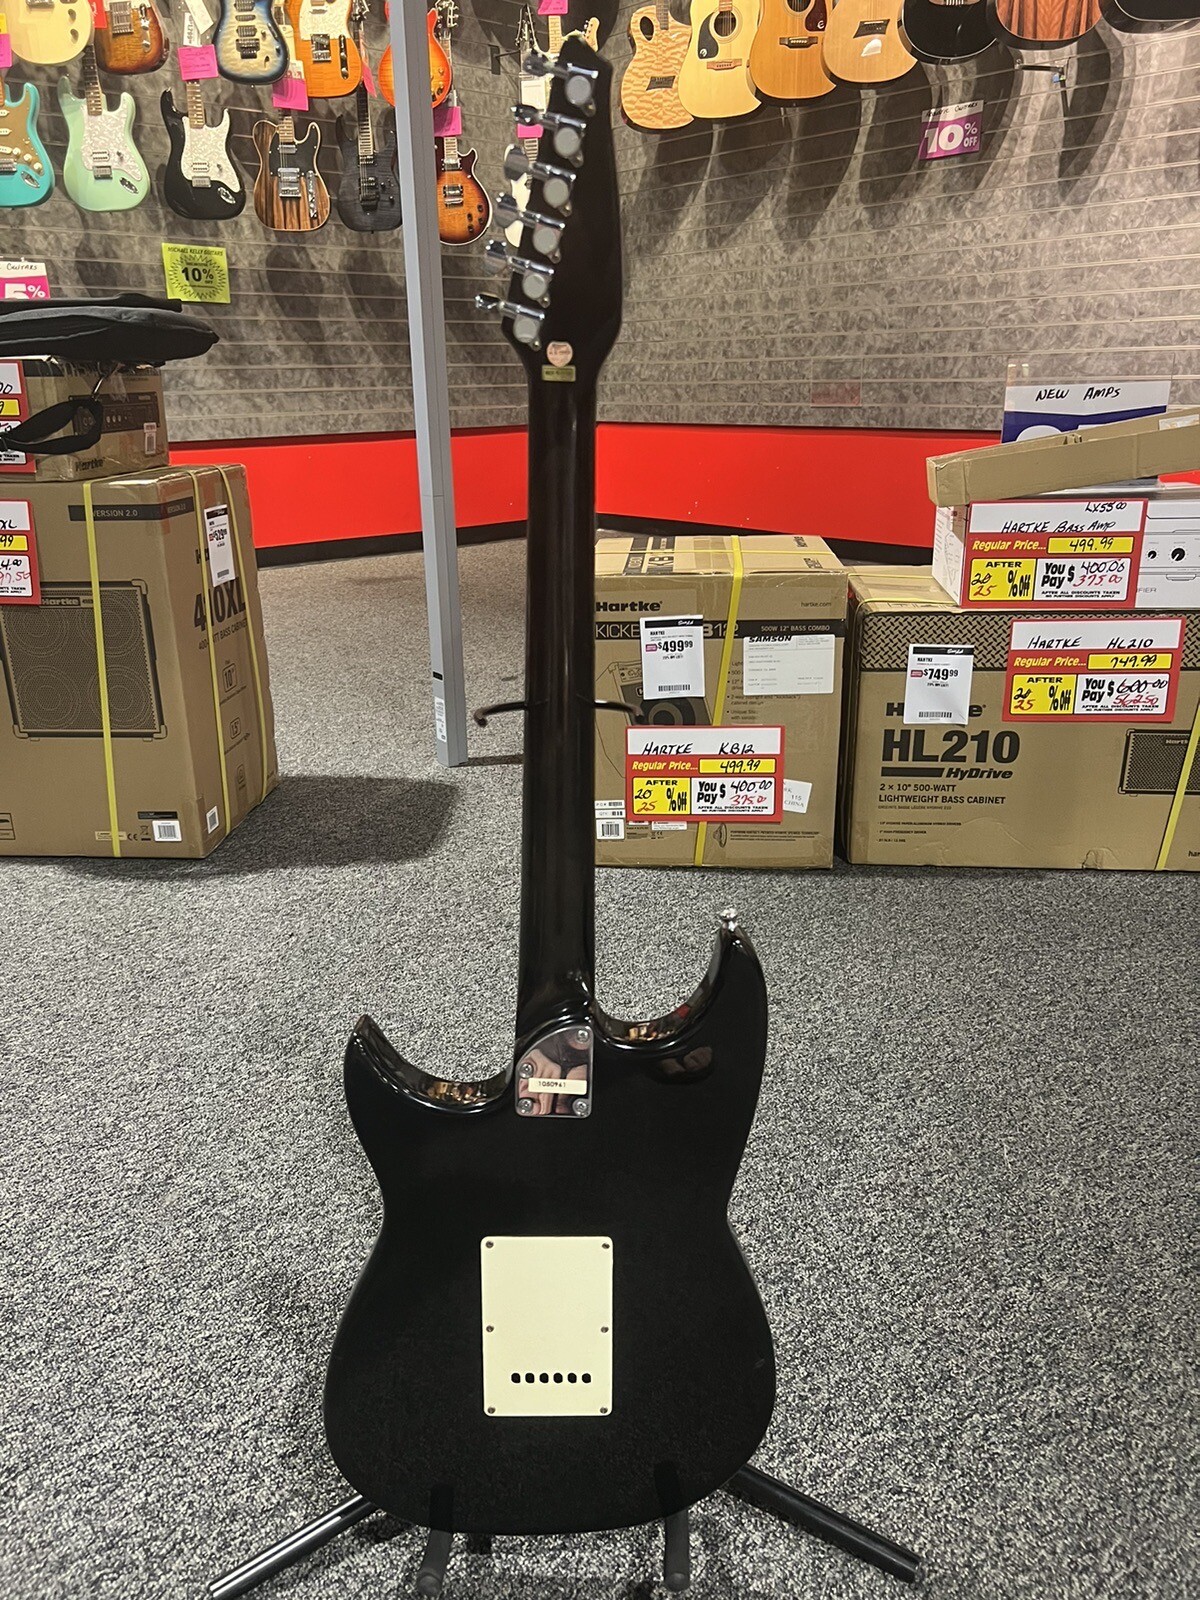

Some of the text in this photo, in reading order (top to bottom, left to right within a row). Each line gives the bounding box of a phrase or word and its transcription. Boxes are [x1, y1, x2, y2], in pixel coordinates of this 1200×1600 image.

[964, 137, 977, 147] OFF
[1036, 389, 1069, 401] NEW
[125, 509, 138, 517] 2.0
[1001, 521, 1050, 533] HARTKE
[972, 540, 1046, 551] Regular Price...
[1069, 537, 1113, 552] 499.99
[1041, 575, 1065, 589] Pay
[973, 585, 997, 596] 25
[595, 601, 661, 612] Hartke
[749, 635, 792, 643] SAMSON
[1027, 636, 1154, 649] HARTKE HL210
[1014, 654, 1157, 668] Regular Price... 749.99
[1081, 690, 1105, 703] Pay
[1014, 699, 1036, 711] 25
[642, 742, 755, 755] HARTKE KB12
[882, 729, 1020, 763] HL210
[632, 760, 760, 774] Regular Price... 499.99
[946, 768, 1013, 780] HyDrive
[635, 789, 652, 799] 20
[697, 793, 718, 804] Pay
[879, 795, 939, 803] LIGHTWEIGHT
[637, 801, 657, 812] 25
